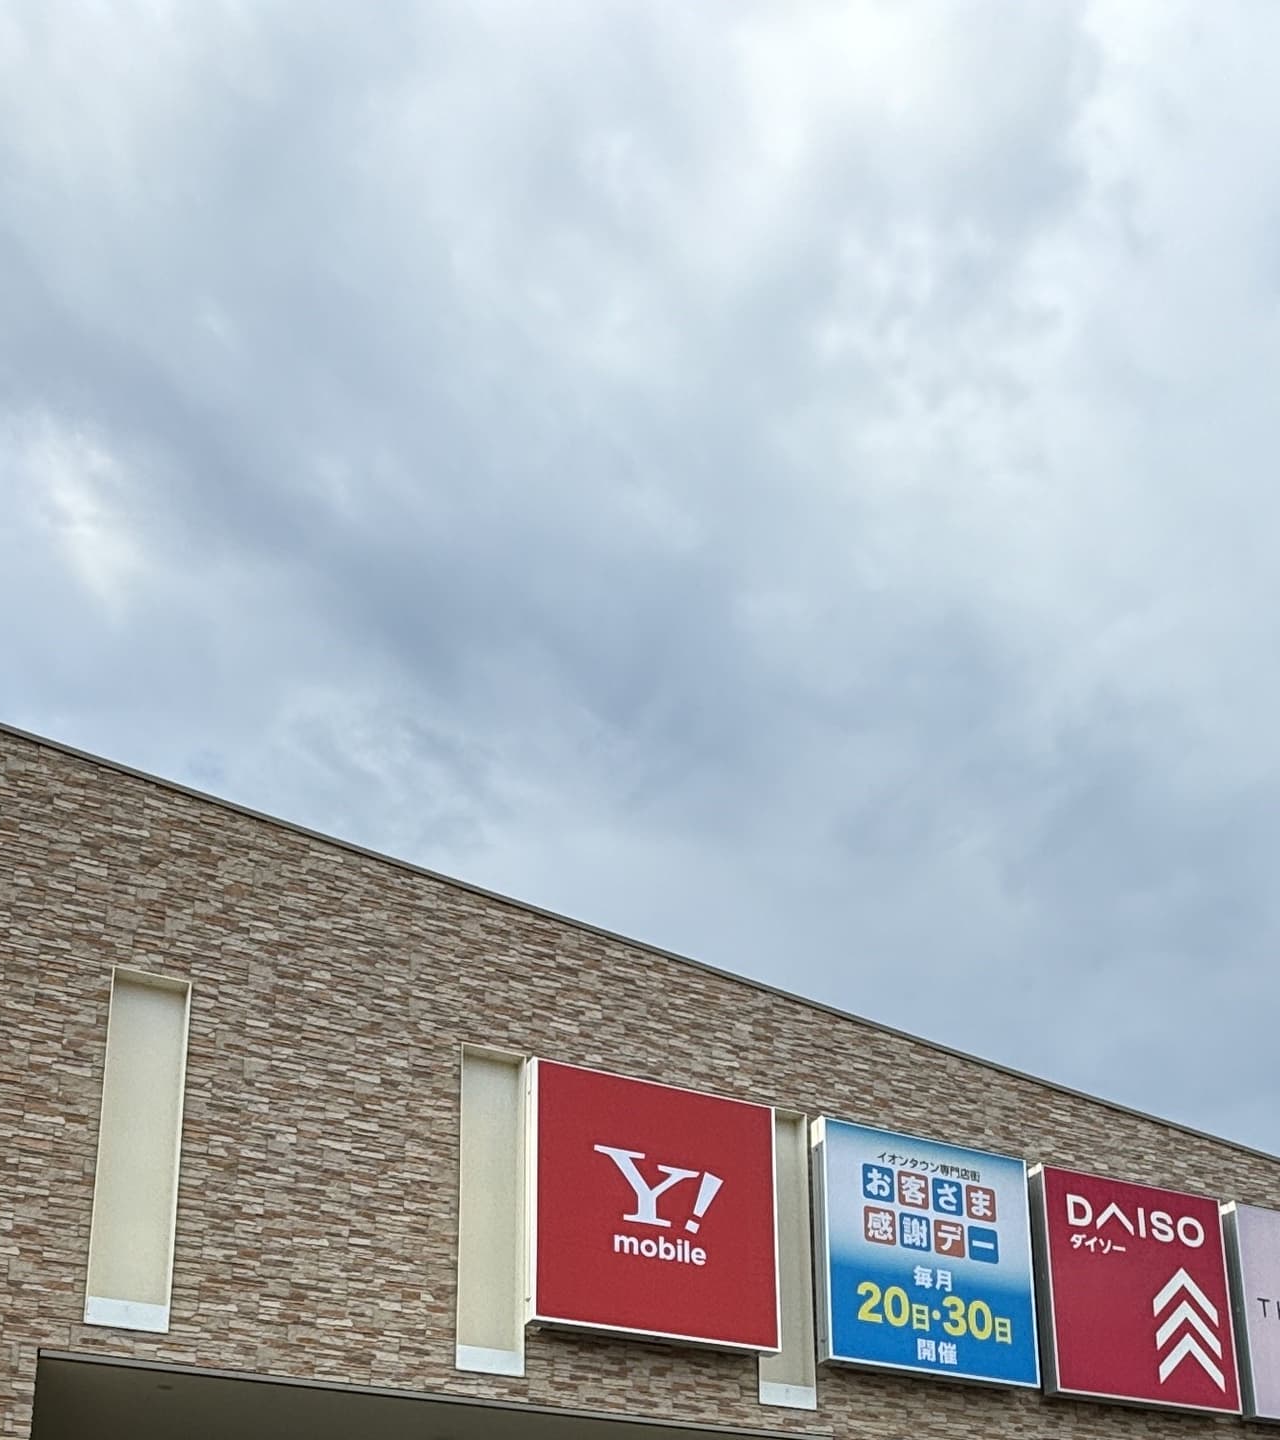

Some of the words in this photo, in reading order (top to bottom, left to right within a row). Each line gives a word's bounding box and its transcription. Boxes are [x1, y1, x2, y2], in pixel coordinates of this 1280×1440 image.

[876, 1151, 982, 1183] イオンタウン専門店街
[593, 1143, 725, 1235] Y!
[865, 1167, 994, 1218] お客さま
[867, 1211, 995, 1251] 感謝デー
[1065, 1193, 1206, 1248] DAISO
[613, 1233, 708, 1267] mobile
[1070, 1233, 1127, 1255] ダイソー
[912, 1264, 953, 1293] 毎月
[916, 1338, 958, 1365] 開催
